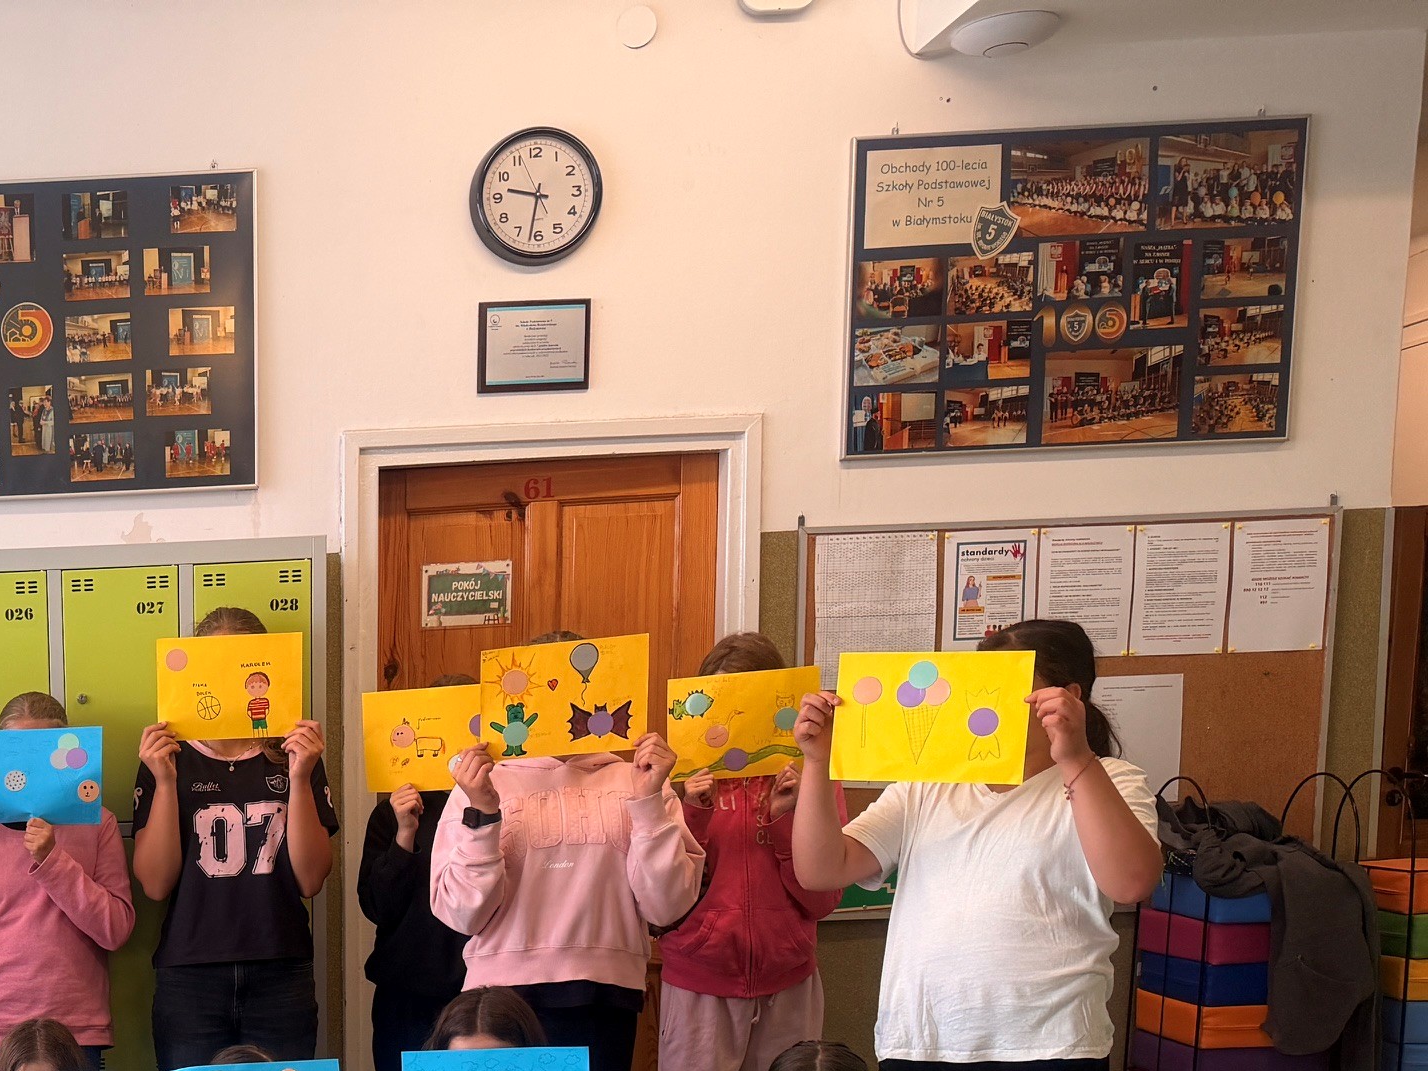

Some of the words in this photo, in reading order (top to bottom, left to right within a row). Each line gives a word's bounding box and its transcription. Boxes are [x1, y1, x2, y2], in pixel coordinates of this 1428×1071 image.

[529, 147, 543, 158] 12
[554, 151, 558, 162] 1
[512, 155, 521, 166] 11
[565, 165, 576, 176] 2
[880, 161, 932, 175] Obchody
[936, 159, 988, 172] 100-lecia
[498, 171, 510, 182] 10
[571, 185, 582, 197] 3
[876, 180, 914, 194] Szkoły
[917, 176, 991, 190] Podstawowej
[492, 192, 503, 204] 9
[917, 197, 933, 208] Nr
[937, 196, 945, 207] 5
[567, 205, 578, 216] 4
[498, 212, 509, 223] 8
[892, 218, 901, 227] w
[905, 214, 972, 228] Białymstoku
[980, 210, 1014, 228] BIAŁYSTOK
[513, 226, 522, 237] 7
[552, 223, 564, 234] 5
[985, 224, 998, 240] 5
[533, 230, 544, 242] 6
[524, 477, 555, 499] 61
[961, 547, 1010, 557] standardy
[452, 578, 481, 591] POKÓJ
[431, 590, 503, 602] NAUCZYCIELSKI
[136, 600, 165, 615] 027
[269, 597, 299, 612] 028
[4, 607, 34, 622] 026
[193, 800, 288, 878] 07
[542, 860, 574, 869] London
